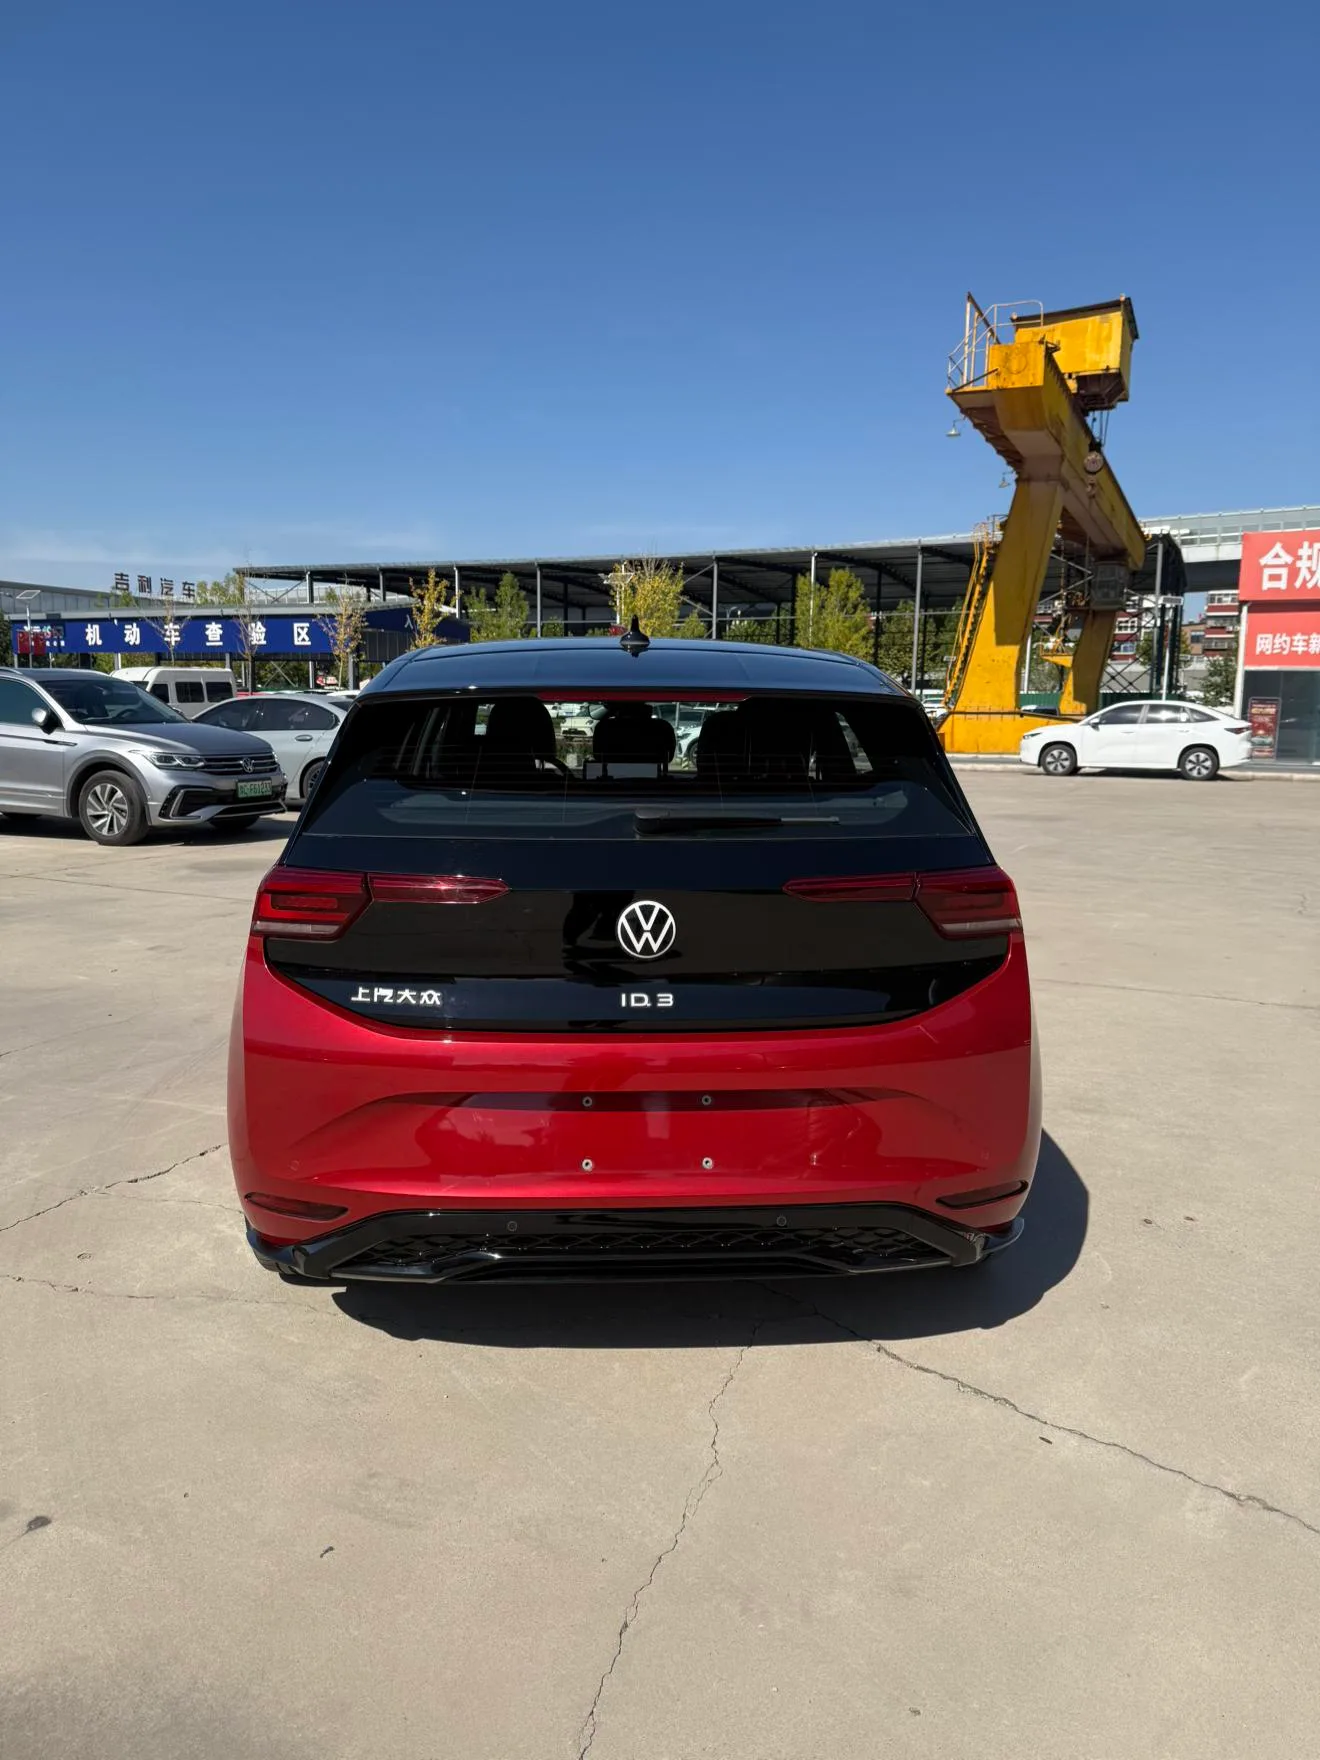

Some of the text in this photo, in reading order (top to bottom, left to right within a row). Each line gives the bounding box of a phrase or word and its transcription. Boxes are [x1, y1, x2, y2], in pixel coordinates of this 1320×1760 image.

[1258, 540, 1320, 591] 合规
[114, 572, 196, 599] 吉利汽车
[85, 621, 312, 646] 机动车查验区
[1255, 631, 1320, 656] 网约车新
[618, 900, 676, 958] VW
[350, 986, 442, 1006] 上汽大众
